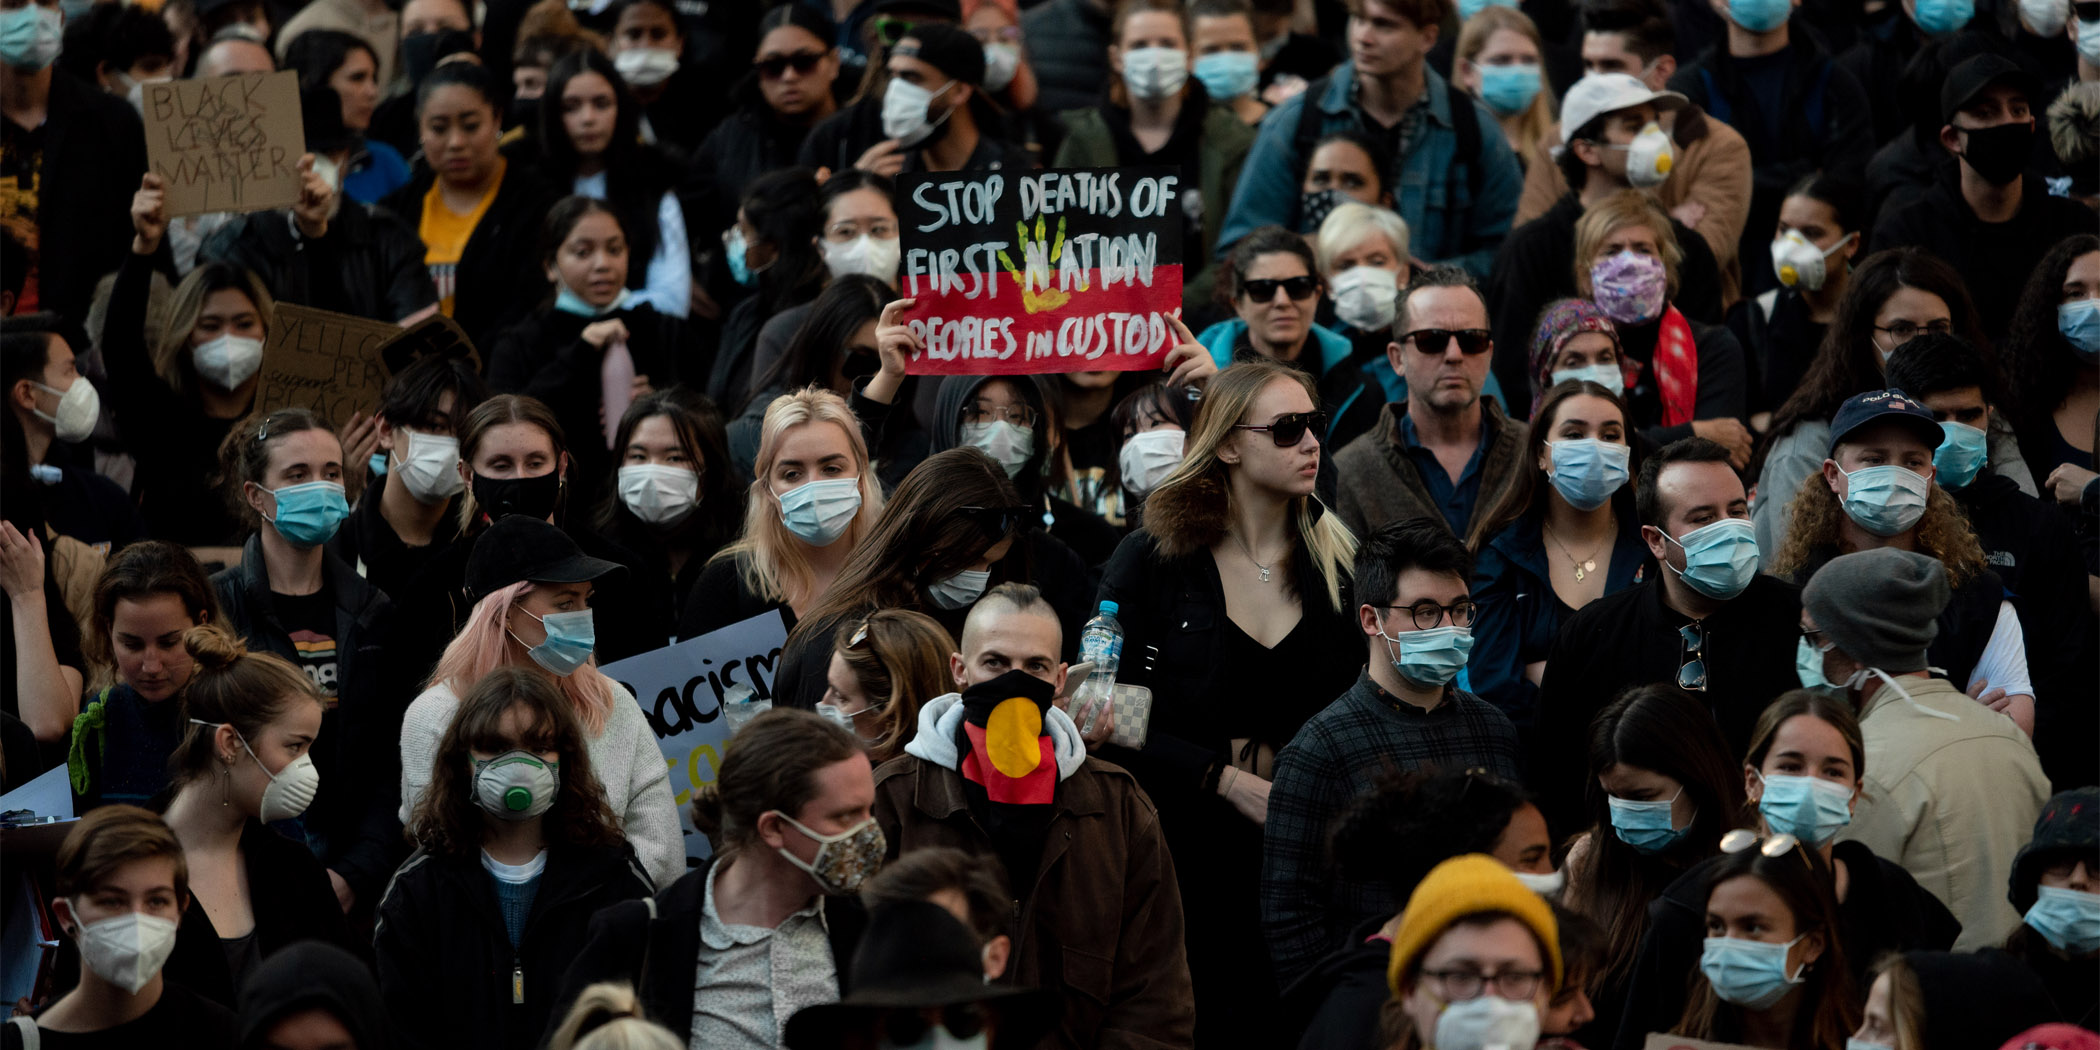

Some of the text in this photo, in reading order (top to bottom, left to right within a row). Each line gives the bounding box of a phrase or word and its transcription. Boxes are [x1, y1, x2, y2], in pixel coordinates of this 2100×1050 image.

[152, 76, 267, 122] BLACK
[167, 113, 267, 152] LIVES
[156, 146, 291, 185] MATTER
[912, 172, 1179, 233] STOP DEATHS OF
[906, 232, 1157, 300] FIRST NATION
[279, 313, 383, 363] YELLO
[907, 307, 1182, 362] PEOPLES IN CUSTODY
[1861, 392, 1890, 403] POLO
